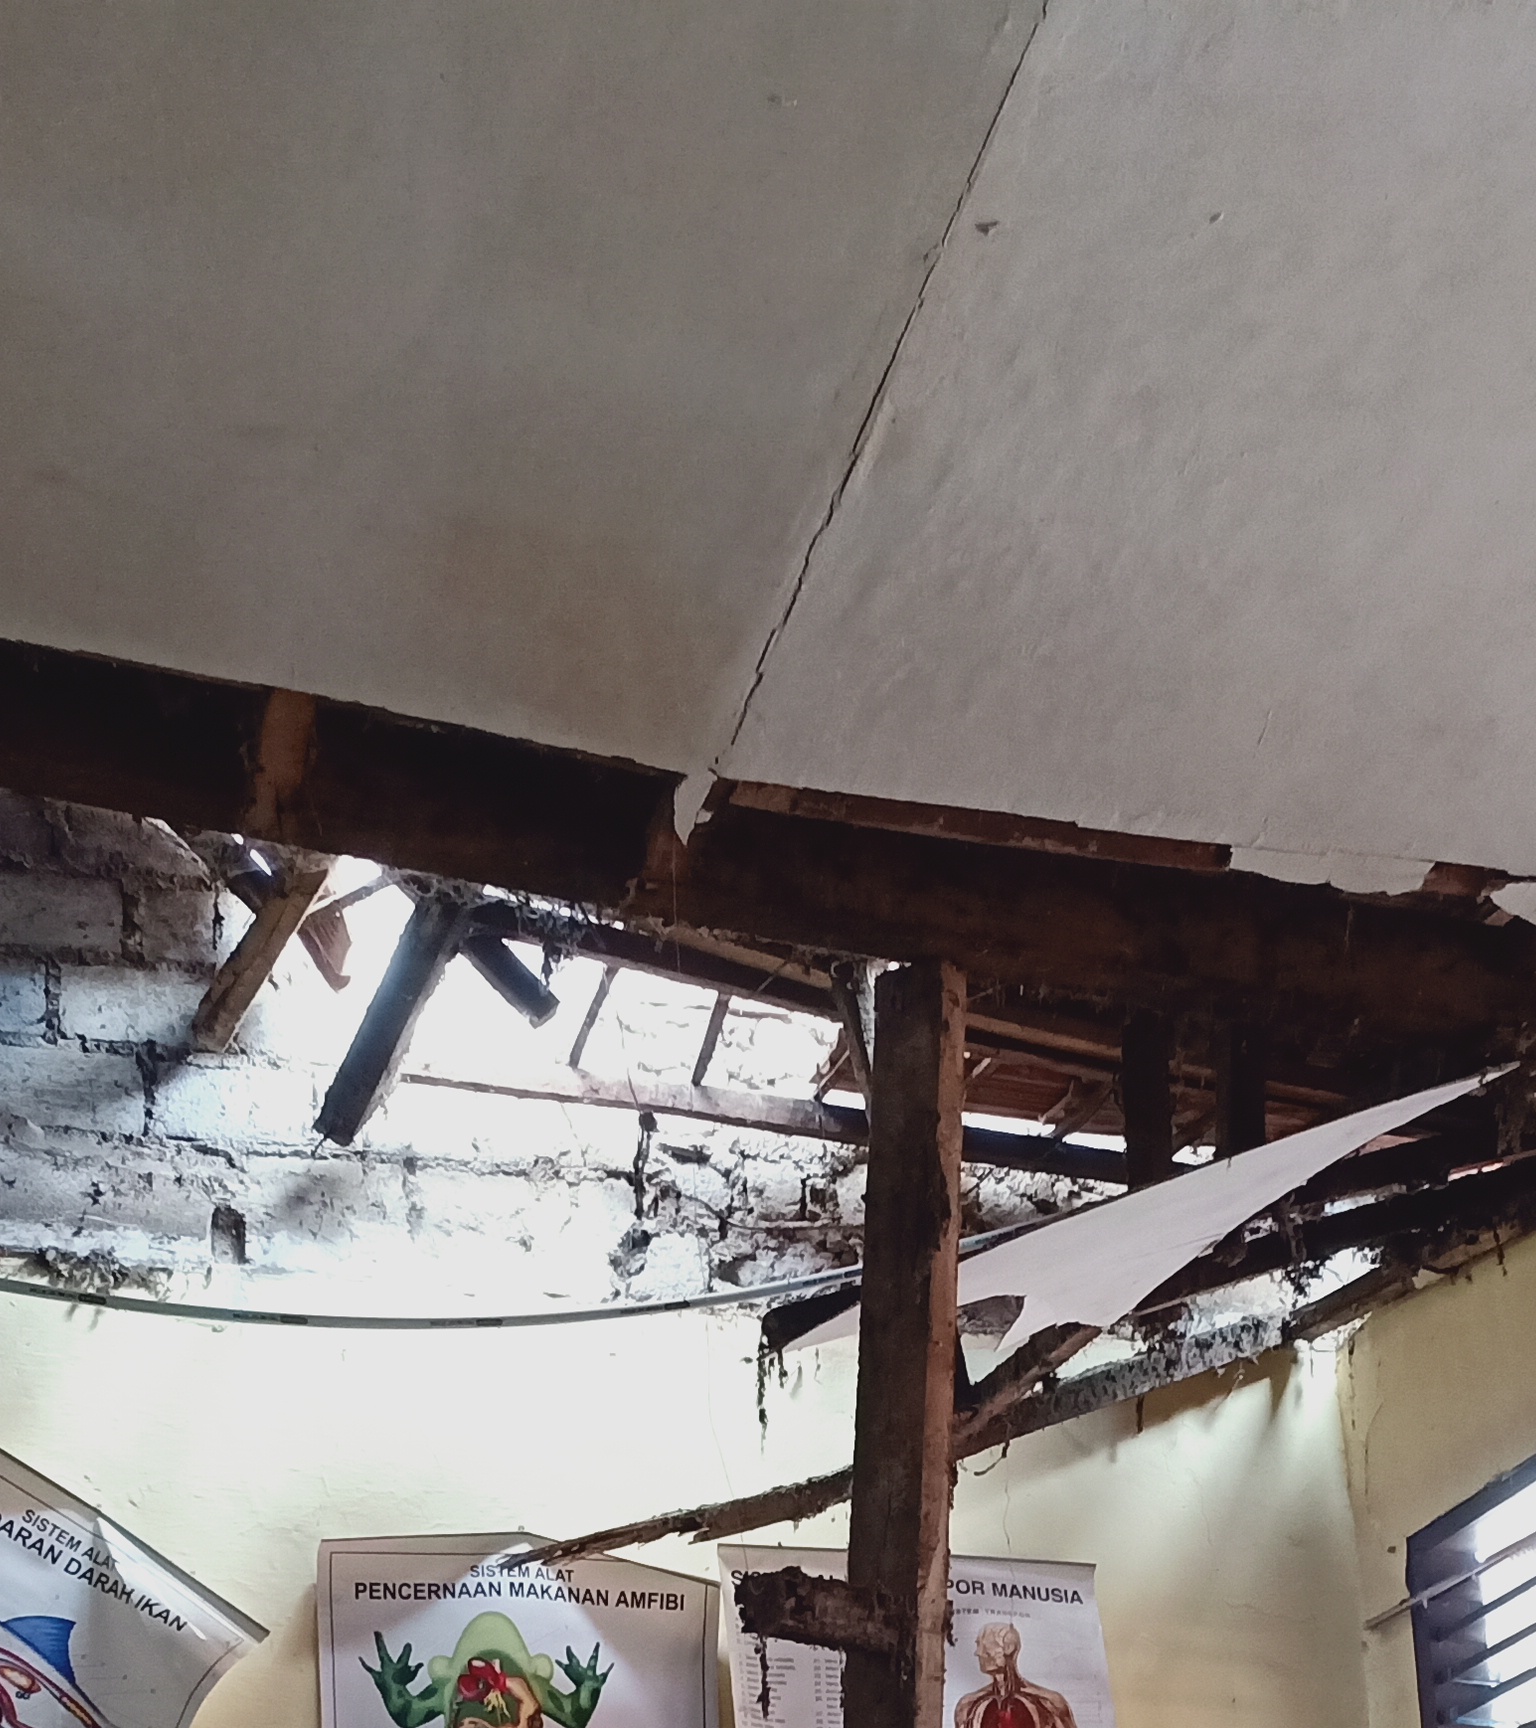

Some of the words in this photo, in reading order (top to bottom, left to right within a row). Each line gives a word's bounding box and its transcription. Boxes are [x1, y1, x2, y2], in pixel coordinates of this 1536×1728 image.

[22, 1508, 82, 1552] SISTEM
[470, 1564, 530, 1579] SISTEM
[535, 1566, 574, 1582] ALAT
[64, 1557, 135, 1605] DARAH
[133, 1594, 188, 1632] IKAN
[354, 1581, 502, 1600] PENCERNAAN
[509, 1582, 609, 1607] MAKANAN
[615, 1591, 685, 1612] AMFIBI
[991, 1582, 1084, 1605] MANUSIA
